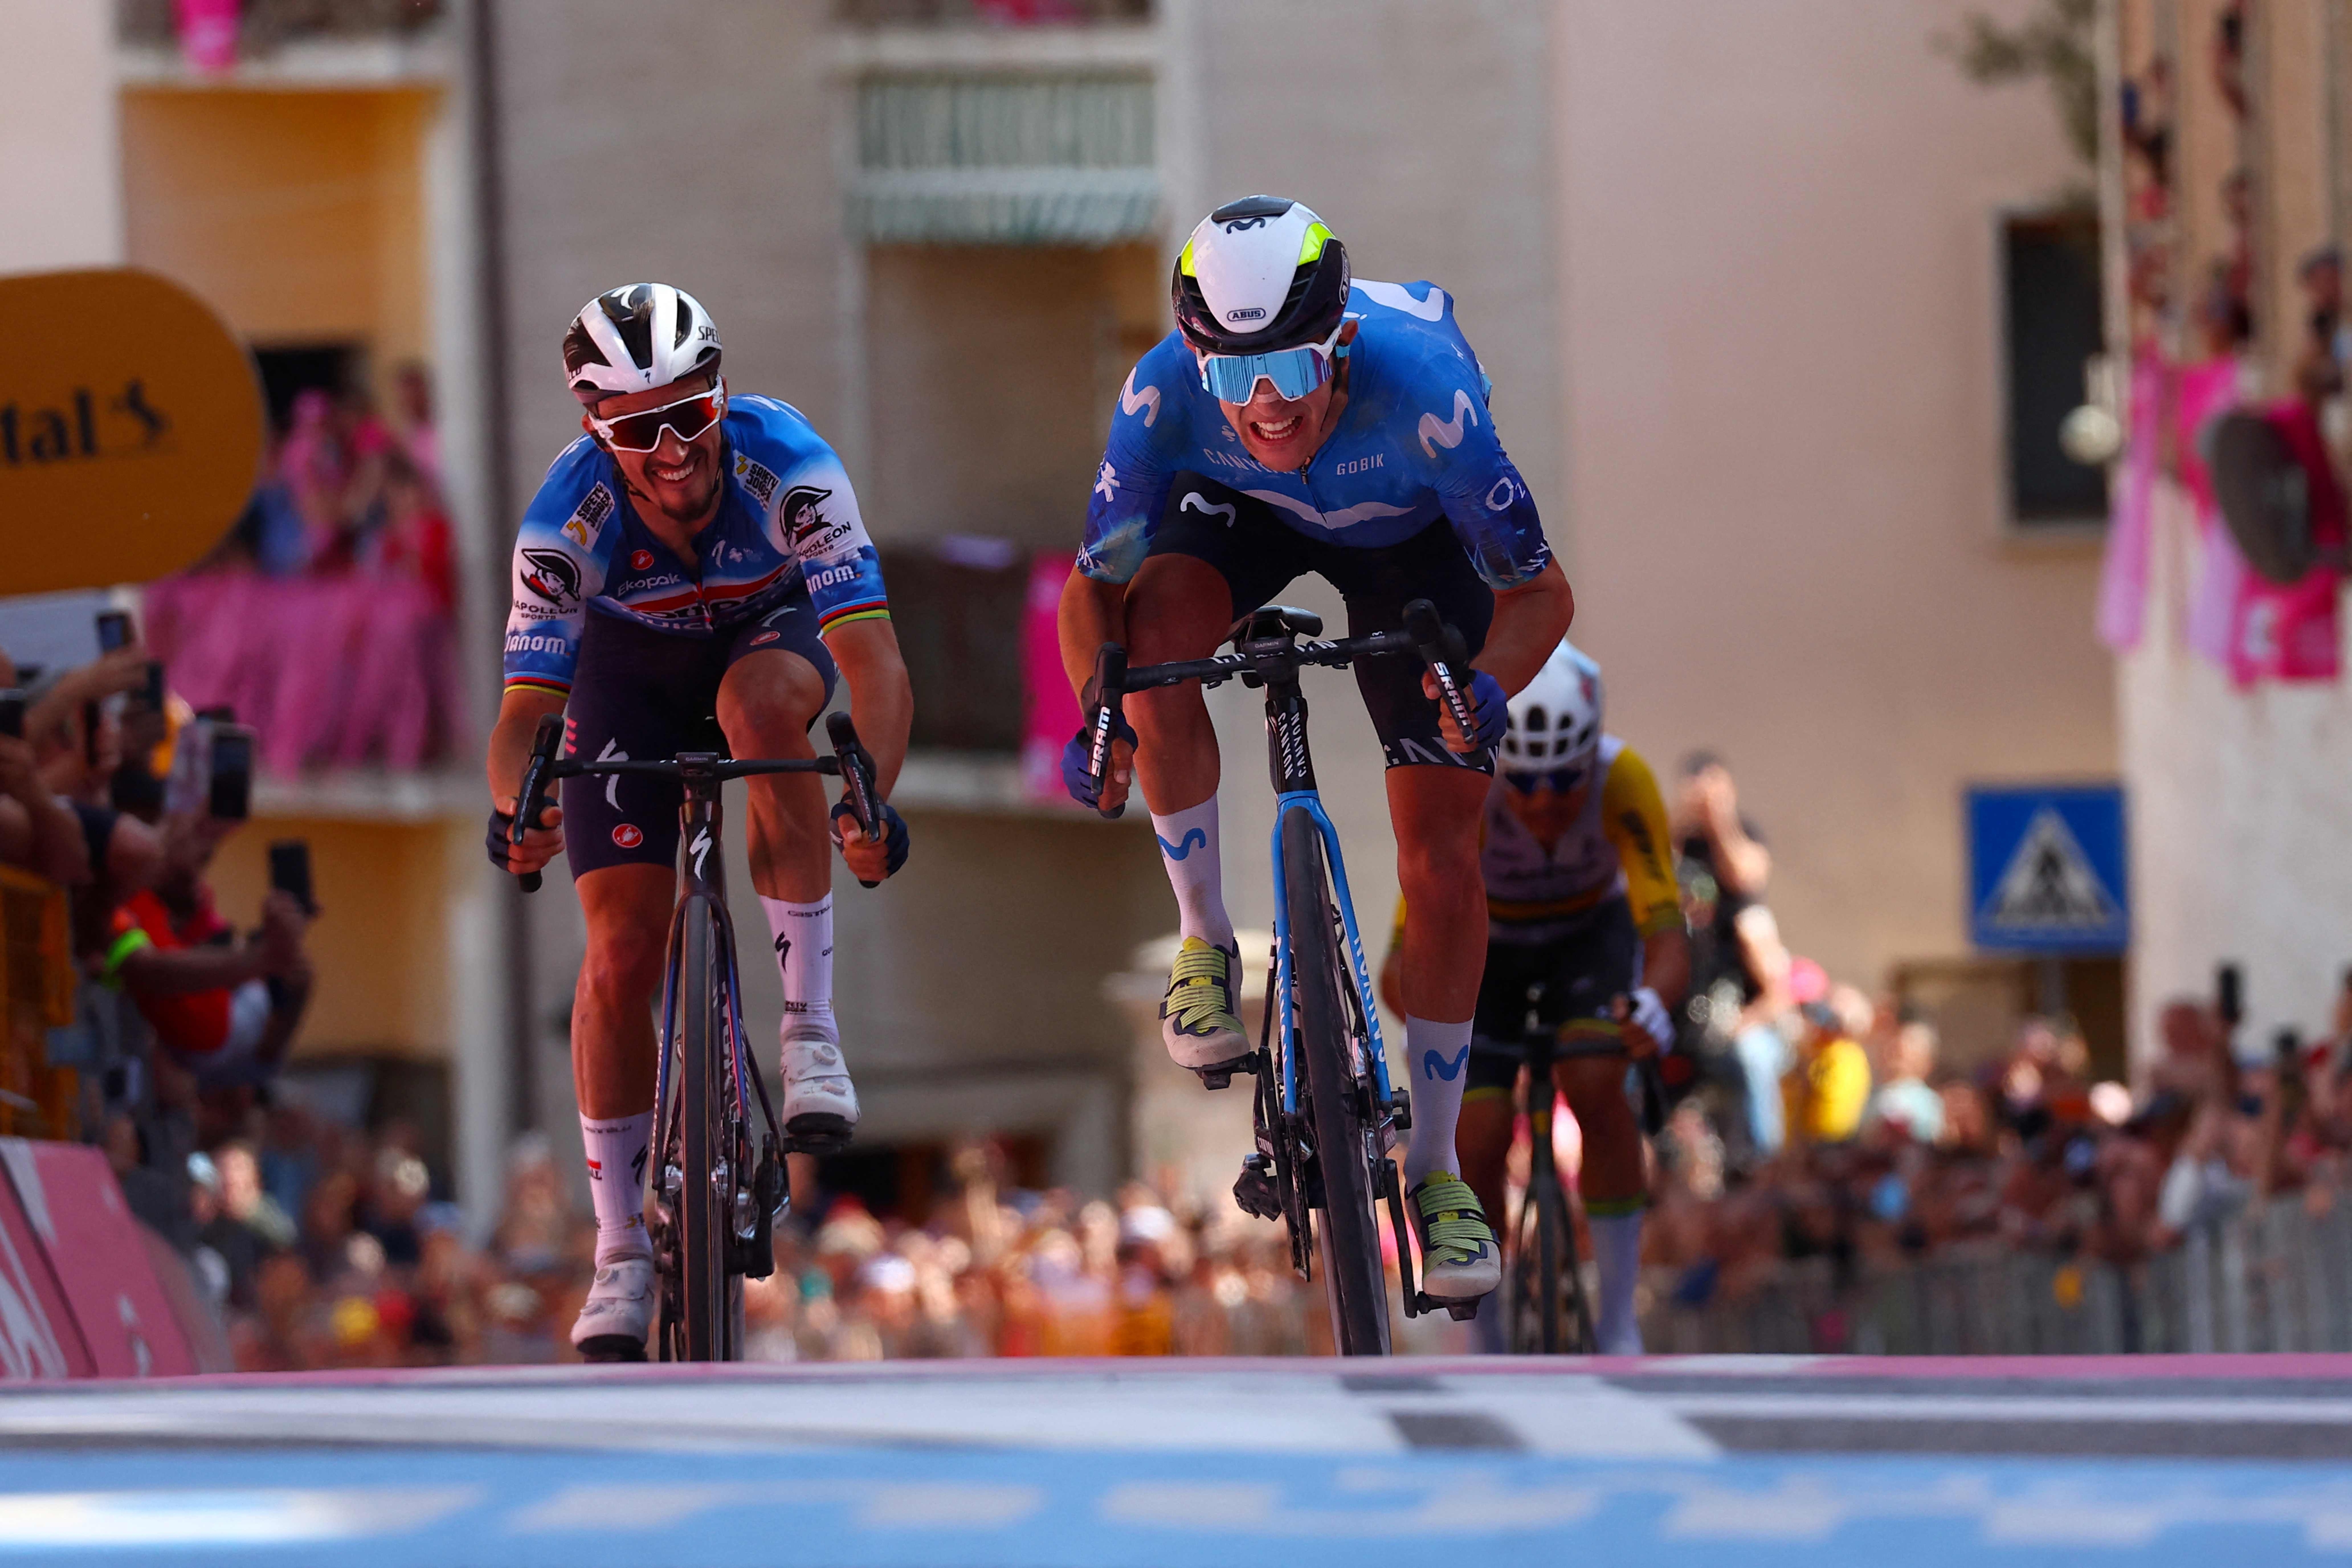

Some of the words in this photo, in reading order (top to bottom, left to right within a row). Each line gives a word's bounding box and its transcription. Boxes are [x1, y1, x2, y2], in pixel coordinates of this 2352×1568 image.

[1232, 310, 1261, 319] ABUS
[1203, 448, 1297, 475] CANY
[1337, 453, 1384, 475] GOBIK
[577, 484, 605, 520] SAFETY
[1255, 640, 1279, 648] GARMIN
[1433, 661, 1471, 726] SRAM
[1091, 706, 1111, 777] SRAM
[1278, 712, 1294, 780] CANYON
